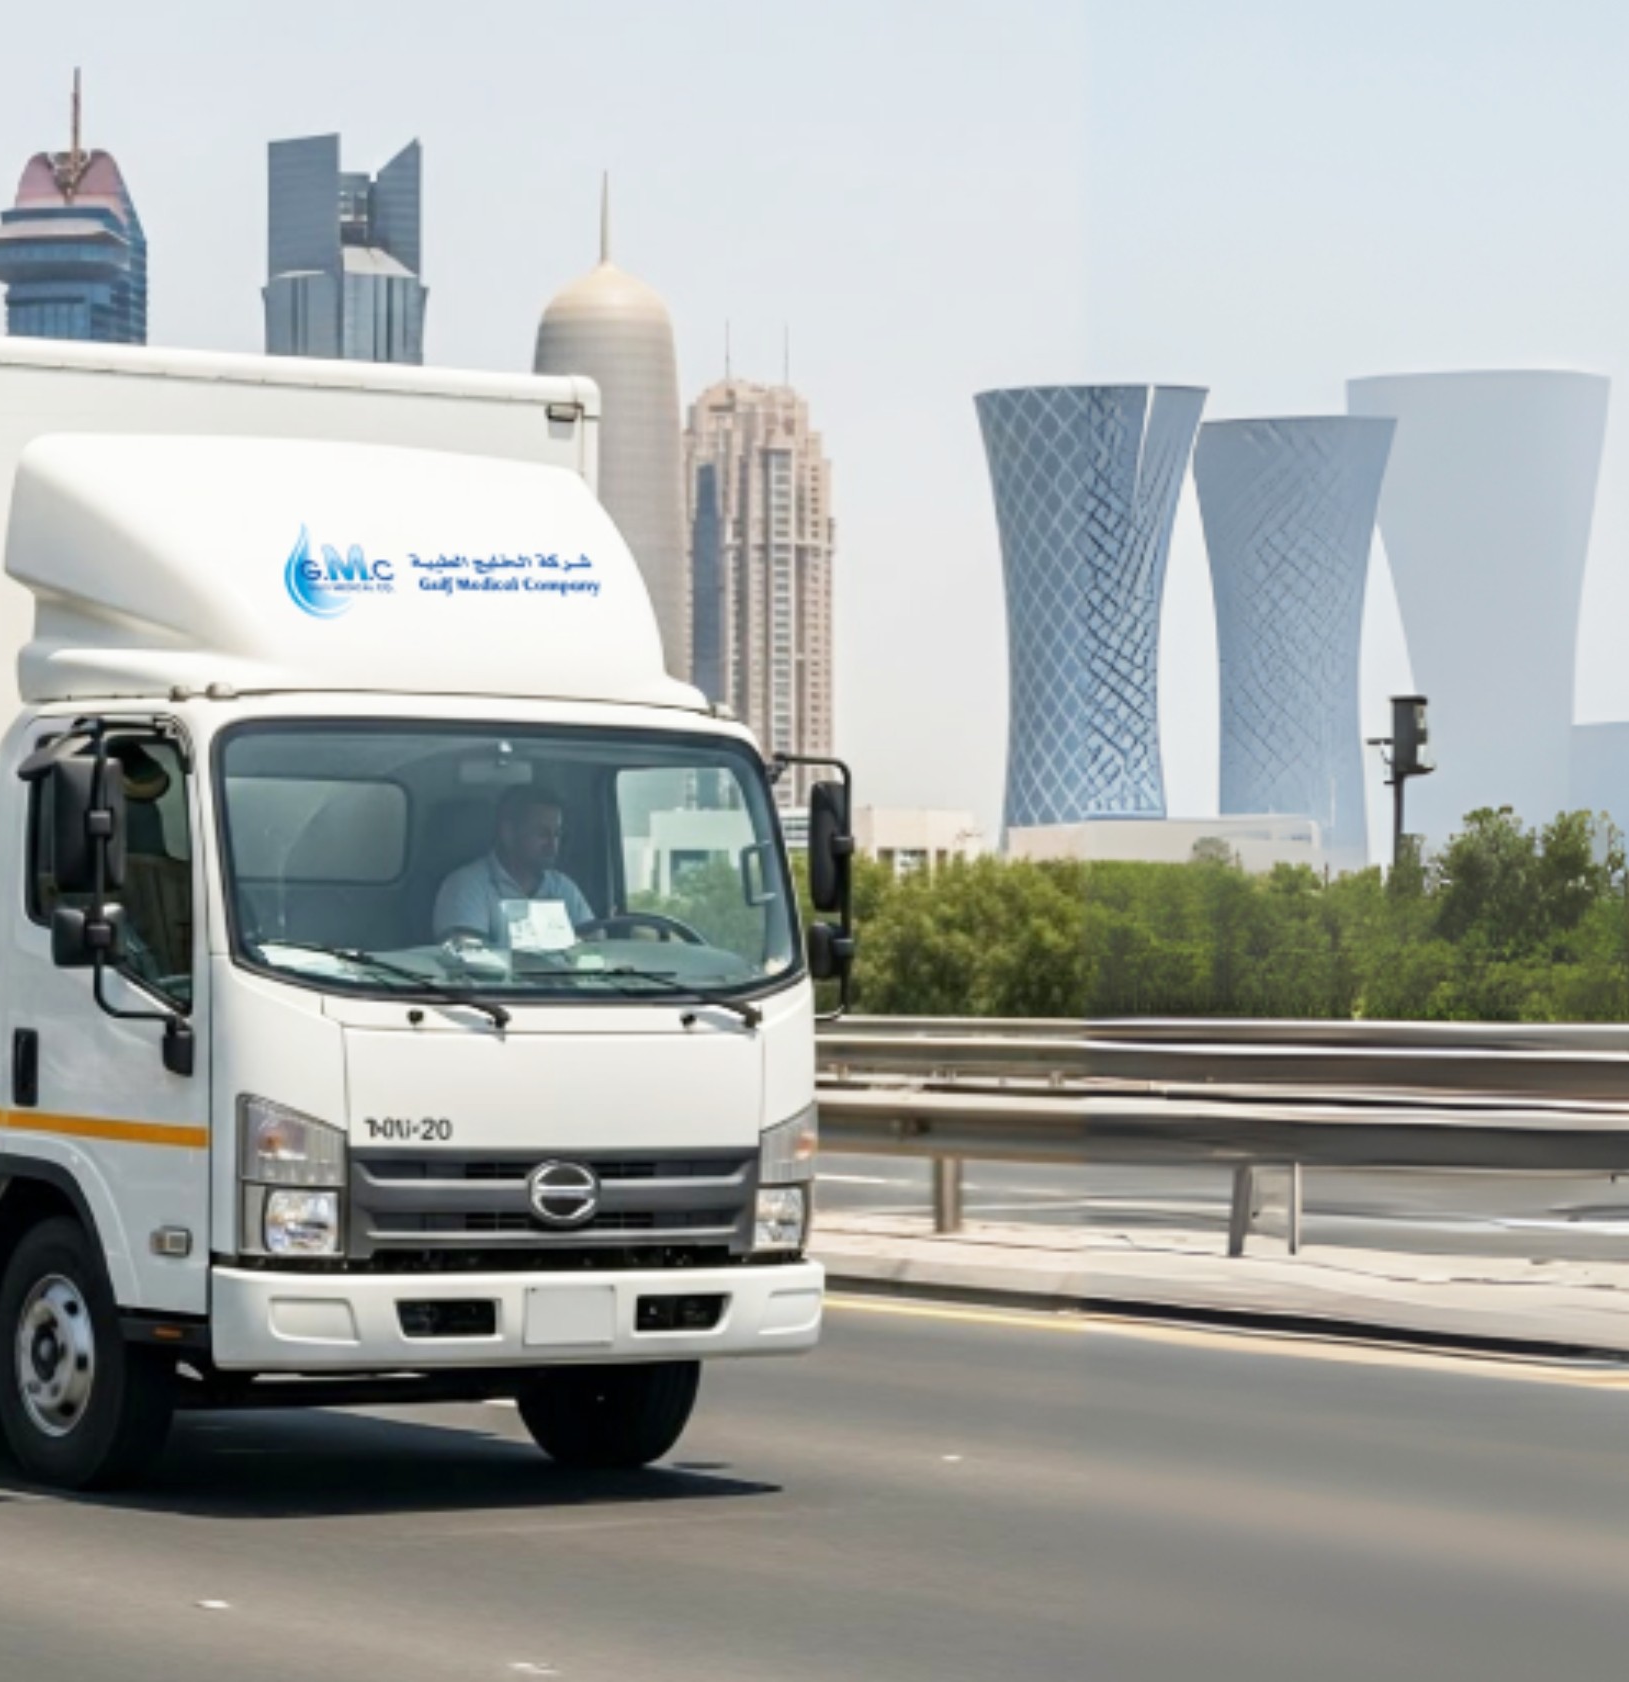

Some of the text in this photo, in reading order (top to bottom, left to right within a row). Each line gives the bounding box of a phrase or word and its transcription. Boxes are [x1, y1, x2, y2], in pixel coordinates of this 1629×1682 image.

[300, 543, 395, 581] G.M.C
[419, 576, 601, 596] Gulf Medical Company
